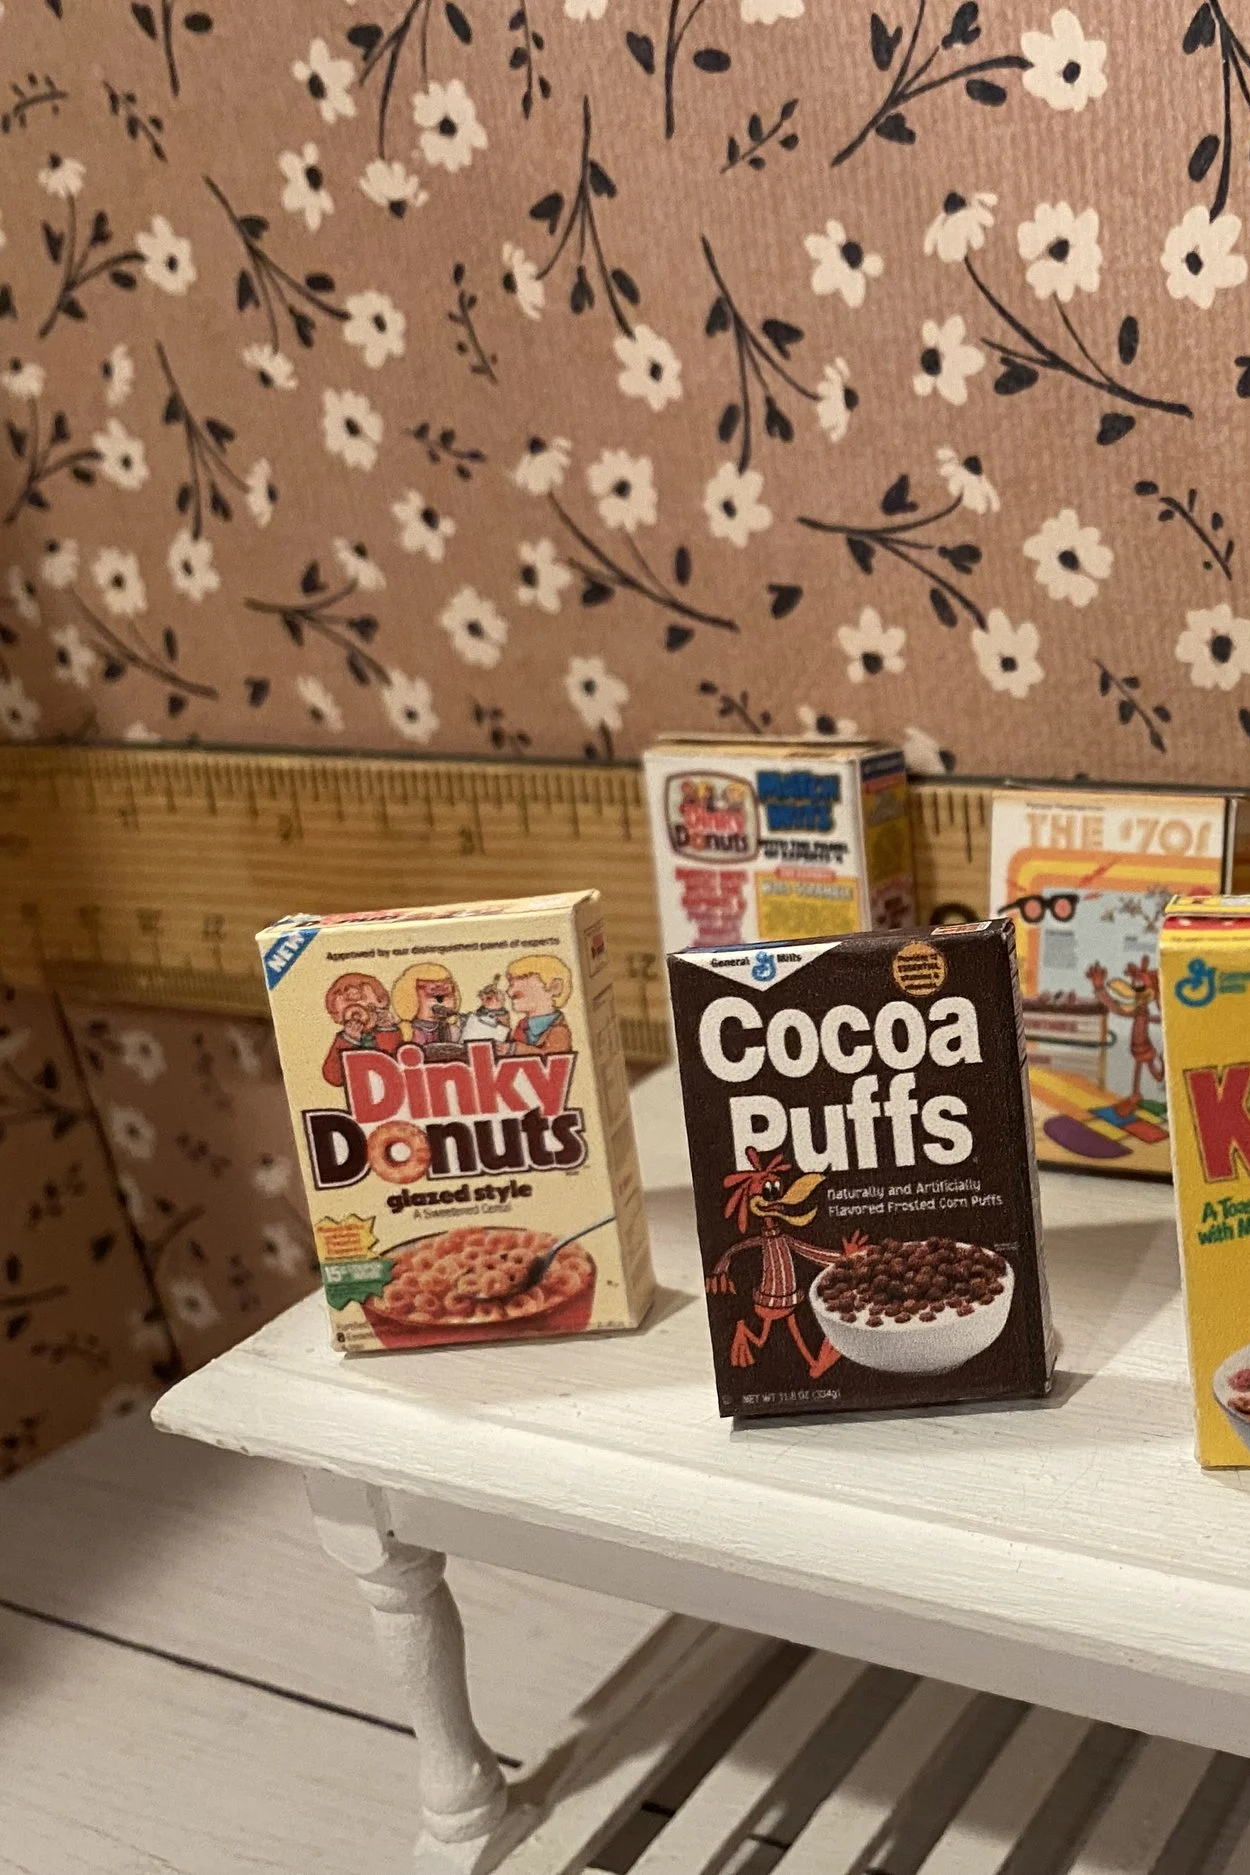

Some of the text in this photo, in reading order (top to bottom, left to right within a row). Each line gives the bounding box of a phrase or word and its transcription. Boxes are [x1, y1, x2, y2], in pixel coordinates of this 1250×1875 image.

[1026, 812, 1104, 849] THE
[266, 931, 305, 974] NEW
[699, 996, 983, 1083] Cocoa
[339, 1038, 579, 1125] Dinky
[728, 1072, 974, 1172] Puffs
[302, 1107, 588, 1190] Donuts
[386, 1179, 534, 1215] glazed style
[828, 1193, 1004, 1217] Flavored Frosted Corn Puffs
[888, 1182, 913, 1196] and
[916, 1179, 982, 1194] Artificially
[1202, 1202, 1218, 1223] A
[1197, 1222, 1235, 1246] with
